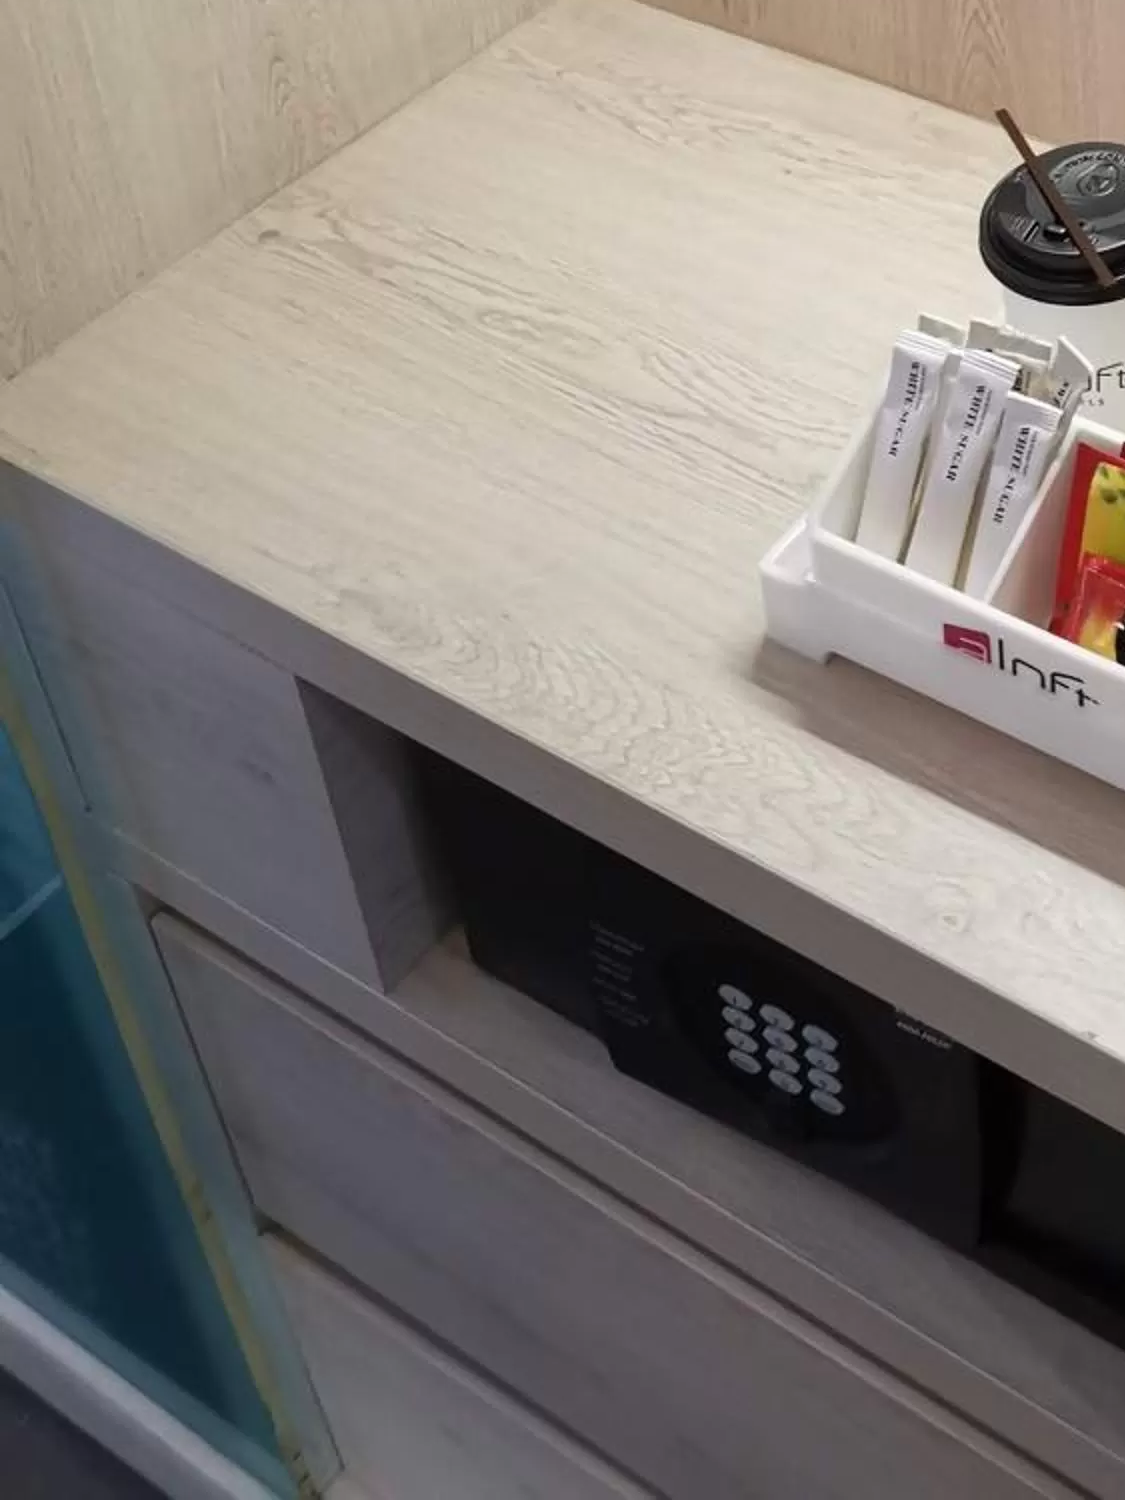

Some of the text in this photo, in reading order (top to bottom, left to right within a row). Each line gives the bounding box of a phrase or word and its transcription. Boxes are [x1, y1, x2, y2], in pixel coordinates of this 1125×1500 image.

[903, 361, 921, 408] WHITE
[963, 384, 987, 429] WHITE
[888, 411, 910, 457] SUGAR
[1009, 427, 1031, 473] WHITE
[945, 434, 969, 482] SUGAR
[992, 477, 1017, 523] SUGAR
